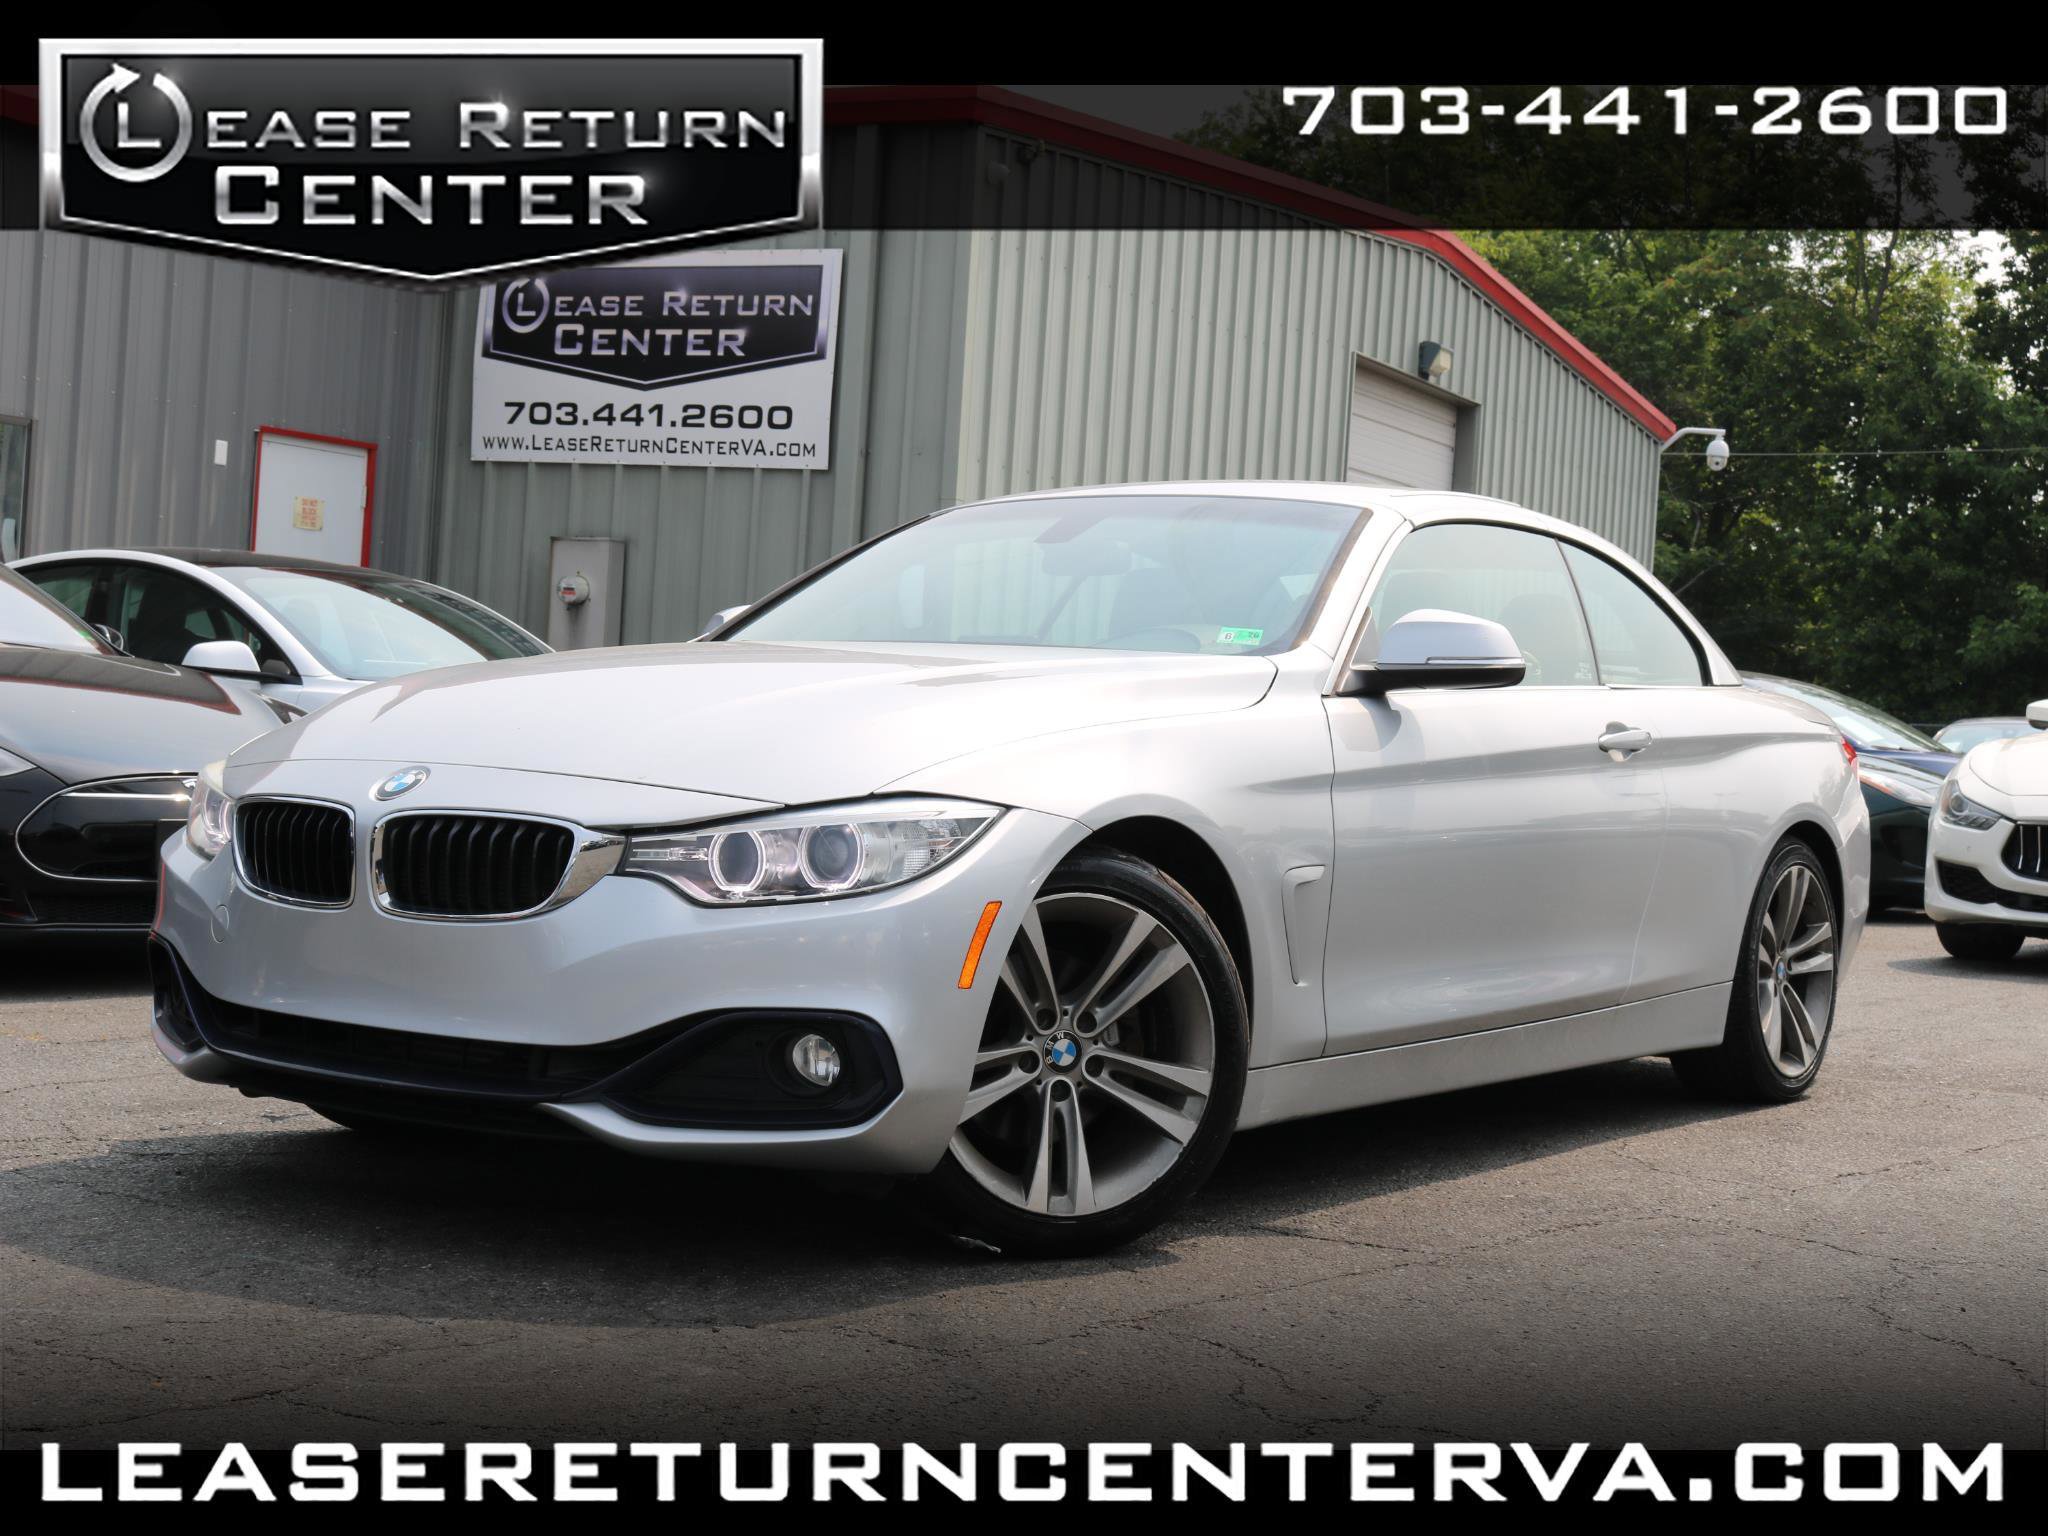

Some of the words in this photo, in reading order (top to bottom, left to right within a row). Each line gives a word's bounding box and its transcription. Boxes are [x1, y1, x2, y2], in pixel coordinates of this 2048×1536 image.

[662, 290, 813, 316] RETURN
[554, 323, 746, 357] CENTER
[504, 401, 793, 430] 703.441.2600
